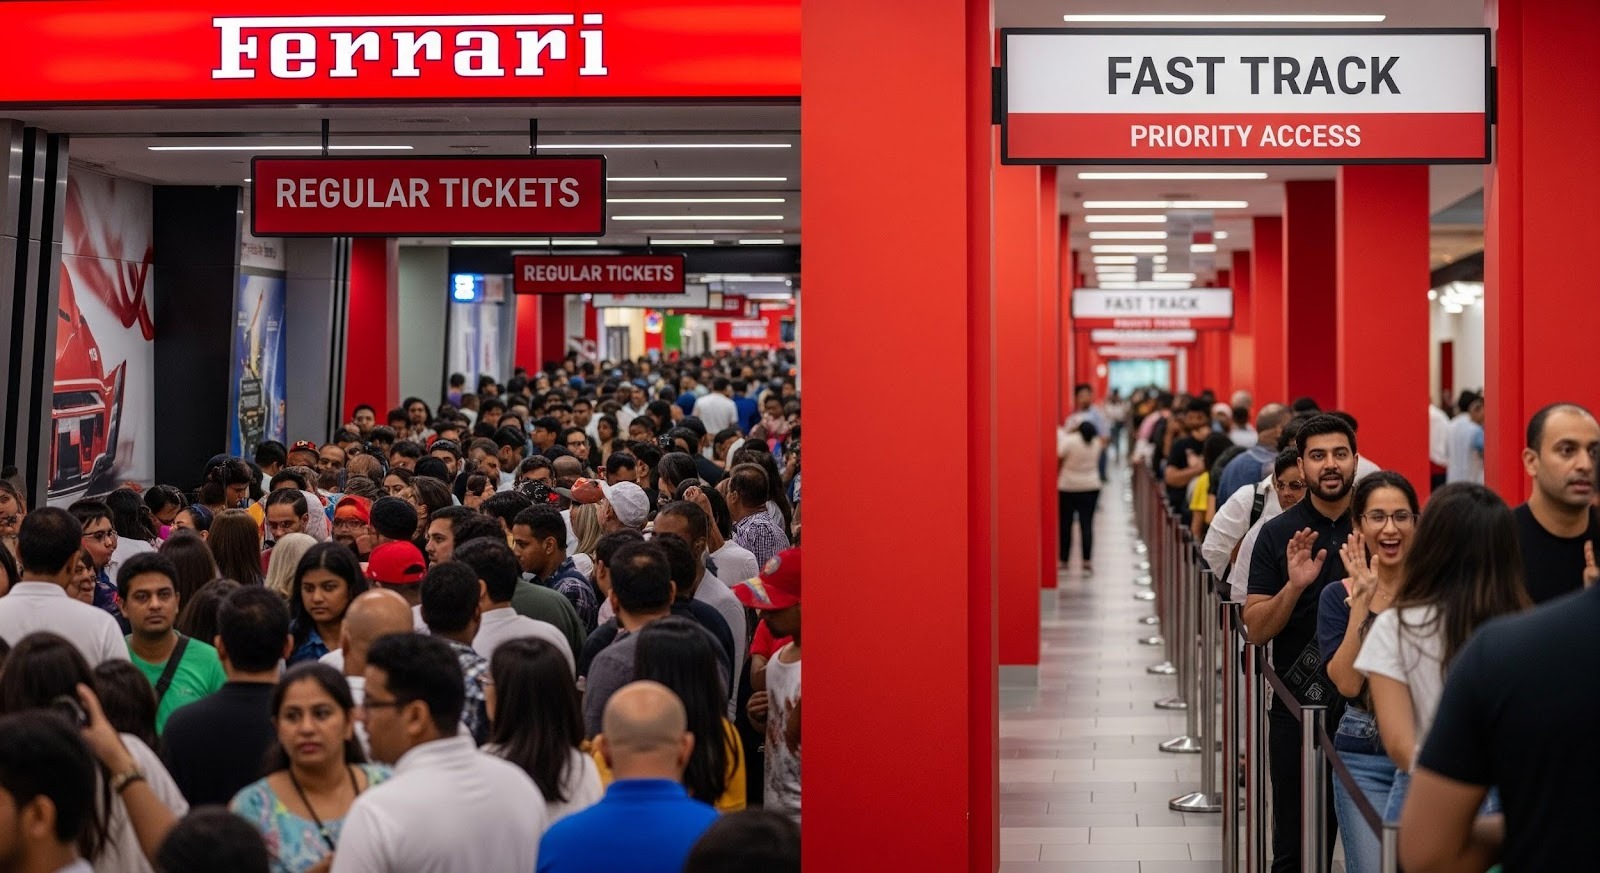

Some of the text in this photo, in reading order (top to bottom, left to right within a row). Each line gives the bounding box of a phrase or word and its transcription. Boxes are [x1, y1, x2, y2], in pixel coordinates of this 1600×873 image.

[211, 13, 608, 79] Ferrari
[1107, 56, 1402, 95] FAST TRACK
[1130, 124, 1361, 148] PRIORITY ACCESS
[276, 177, 580, 208] REGULAR TICKETS
[523, 264, 674, 282] REGULAR TICKETS
[1105, 296, 1199, 310] FAST TRACK
